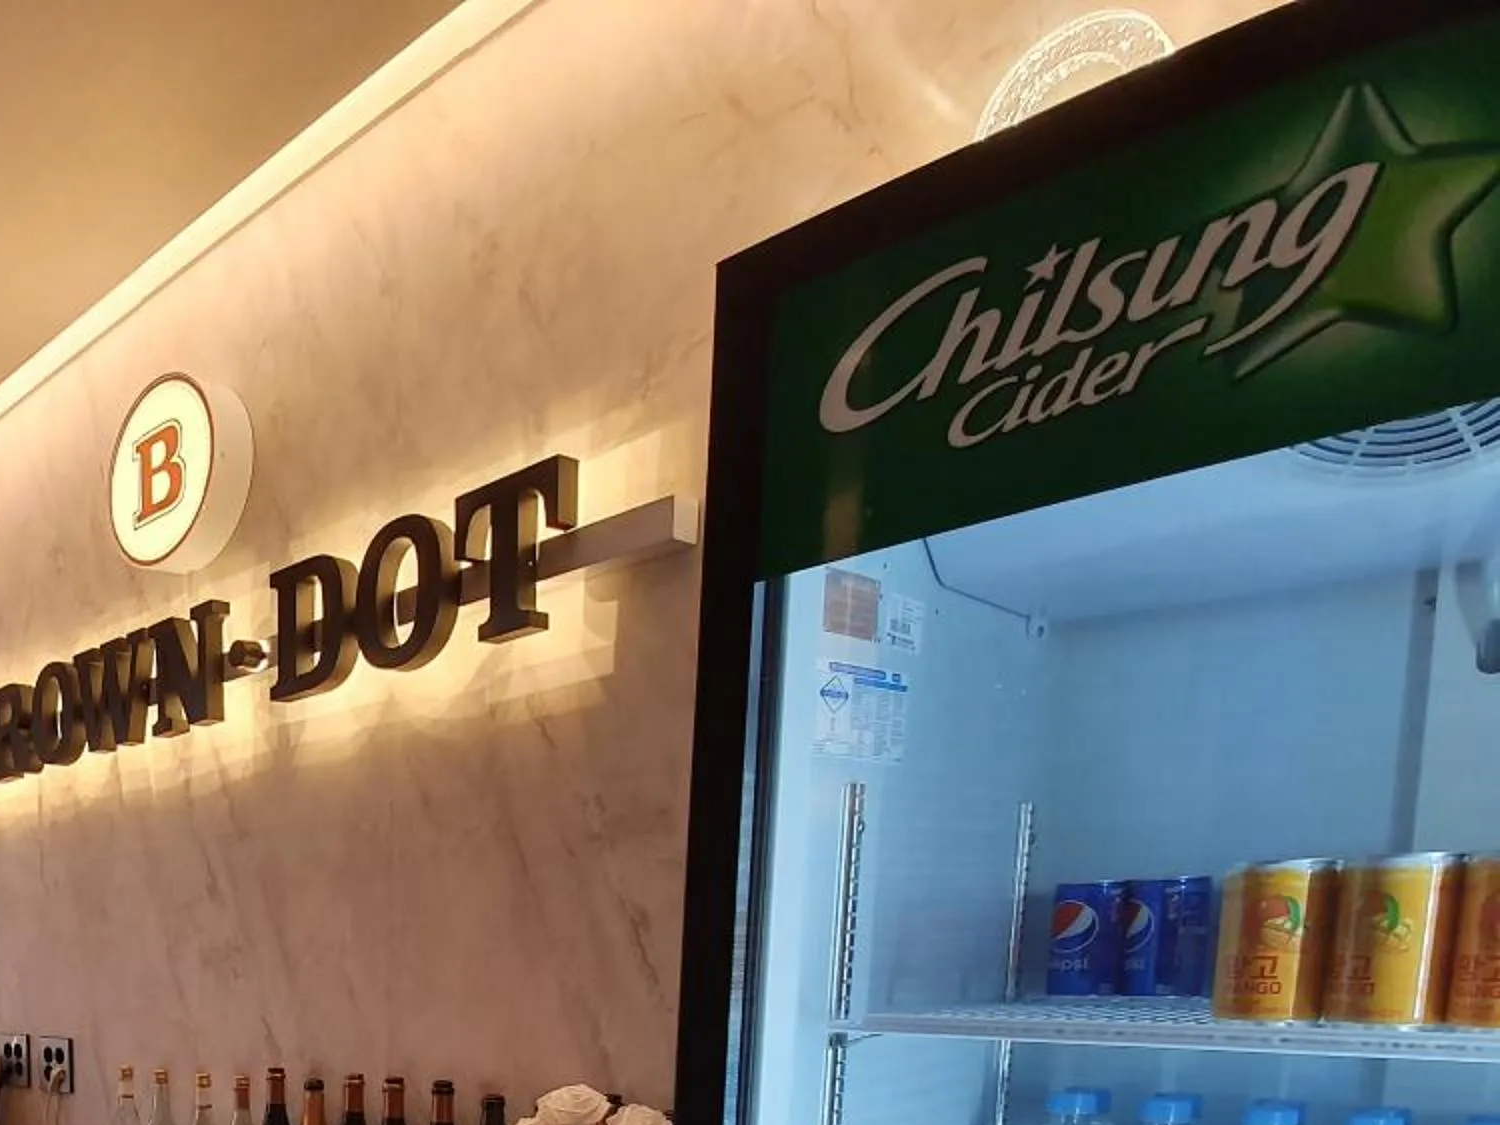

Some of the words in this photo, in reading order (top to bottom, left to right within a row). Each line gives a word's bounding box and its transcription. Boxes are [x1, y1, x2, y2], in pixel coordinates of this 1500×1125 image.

[819, 161, 1380, 433] Chilsung
[947, 317, 1206, 449] Cider
[132, 418, 187, 531] B
